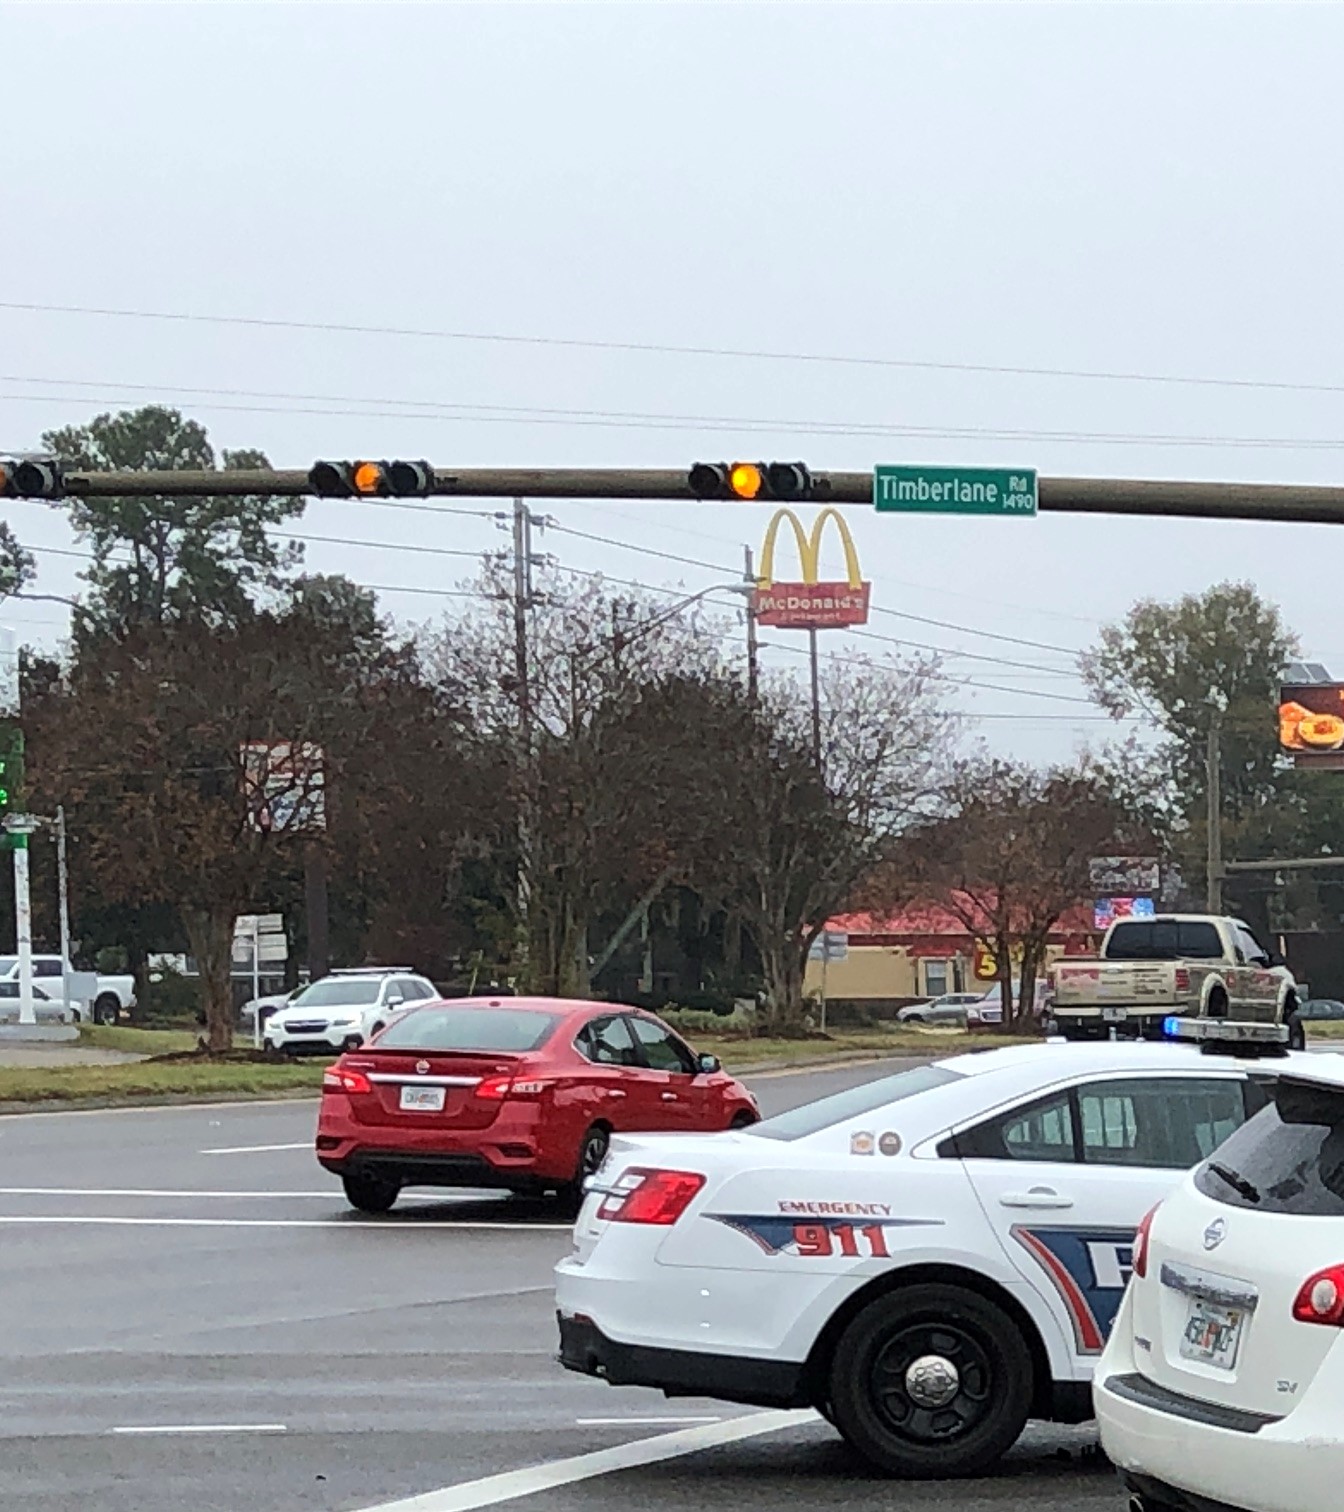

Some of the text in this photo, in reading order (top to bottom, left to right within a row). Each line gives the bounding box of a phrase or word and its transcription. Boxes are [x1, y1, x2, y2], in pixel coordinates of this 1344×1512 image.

[879, 474, 1028, 503] Timberlane Rd
[1002, 493, 1034, 510] 1490
[777, 1200, 892, 1216] EMERGENCY
[793, 1223, 892, 1259] 911
